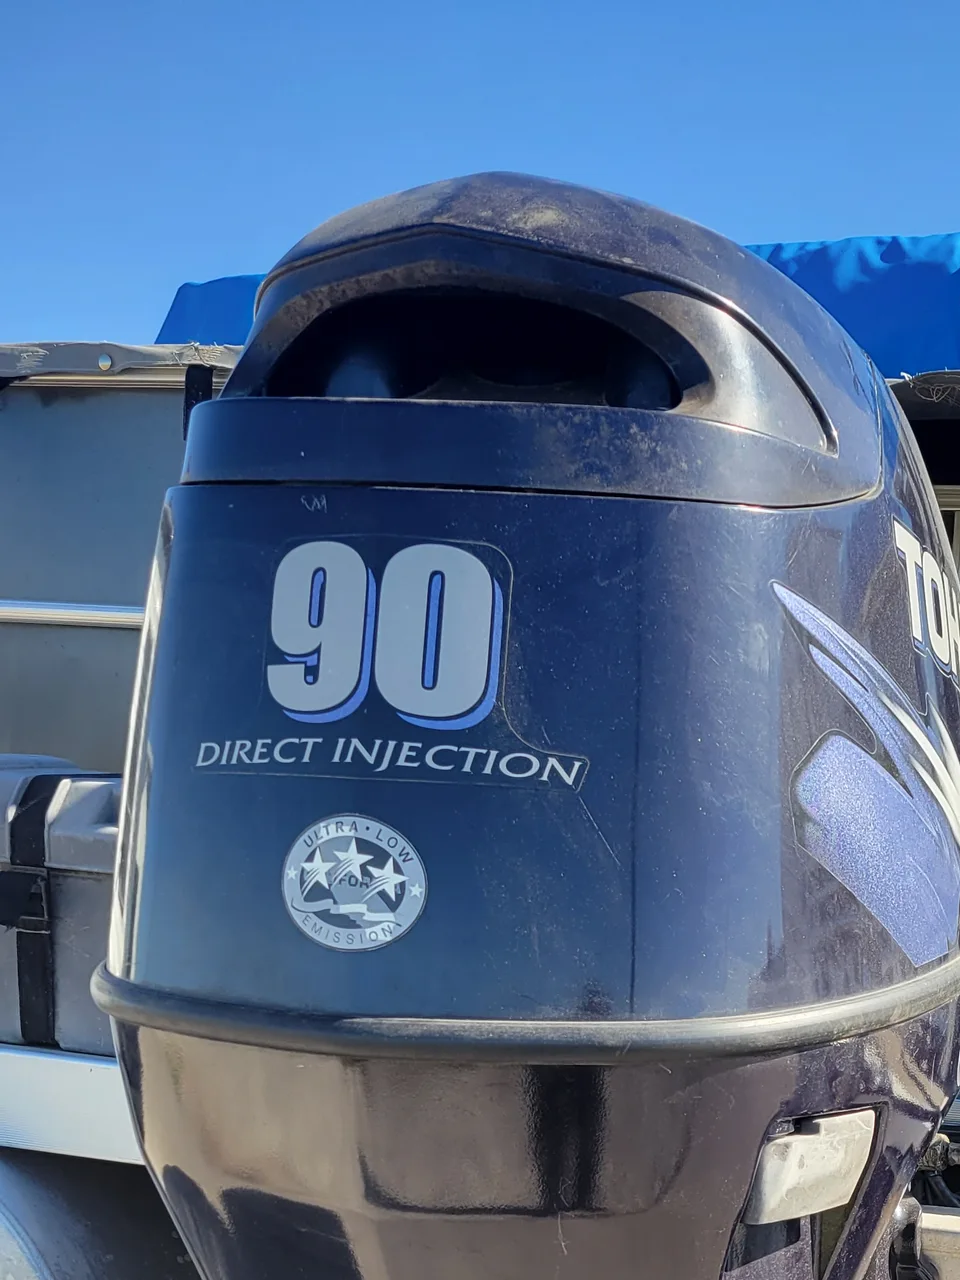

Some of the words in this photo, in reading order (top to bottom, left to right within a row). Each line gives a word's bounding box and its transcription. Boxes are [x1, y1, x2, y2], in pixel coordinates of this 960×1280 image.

[267, 540, 503, 730] 90
[196, 737, 322, 767] DIRECT
[330, 737, 584, 786] INJECTION
[303, 820, 359, 848] ULTRA
[376, 828, 414, 864] LOW
[302, 914, 394, 945] EMISSION
